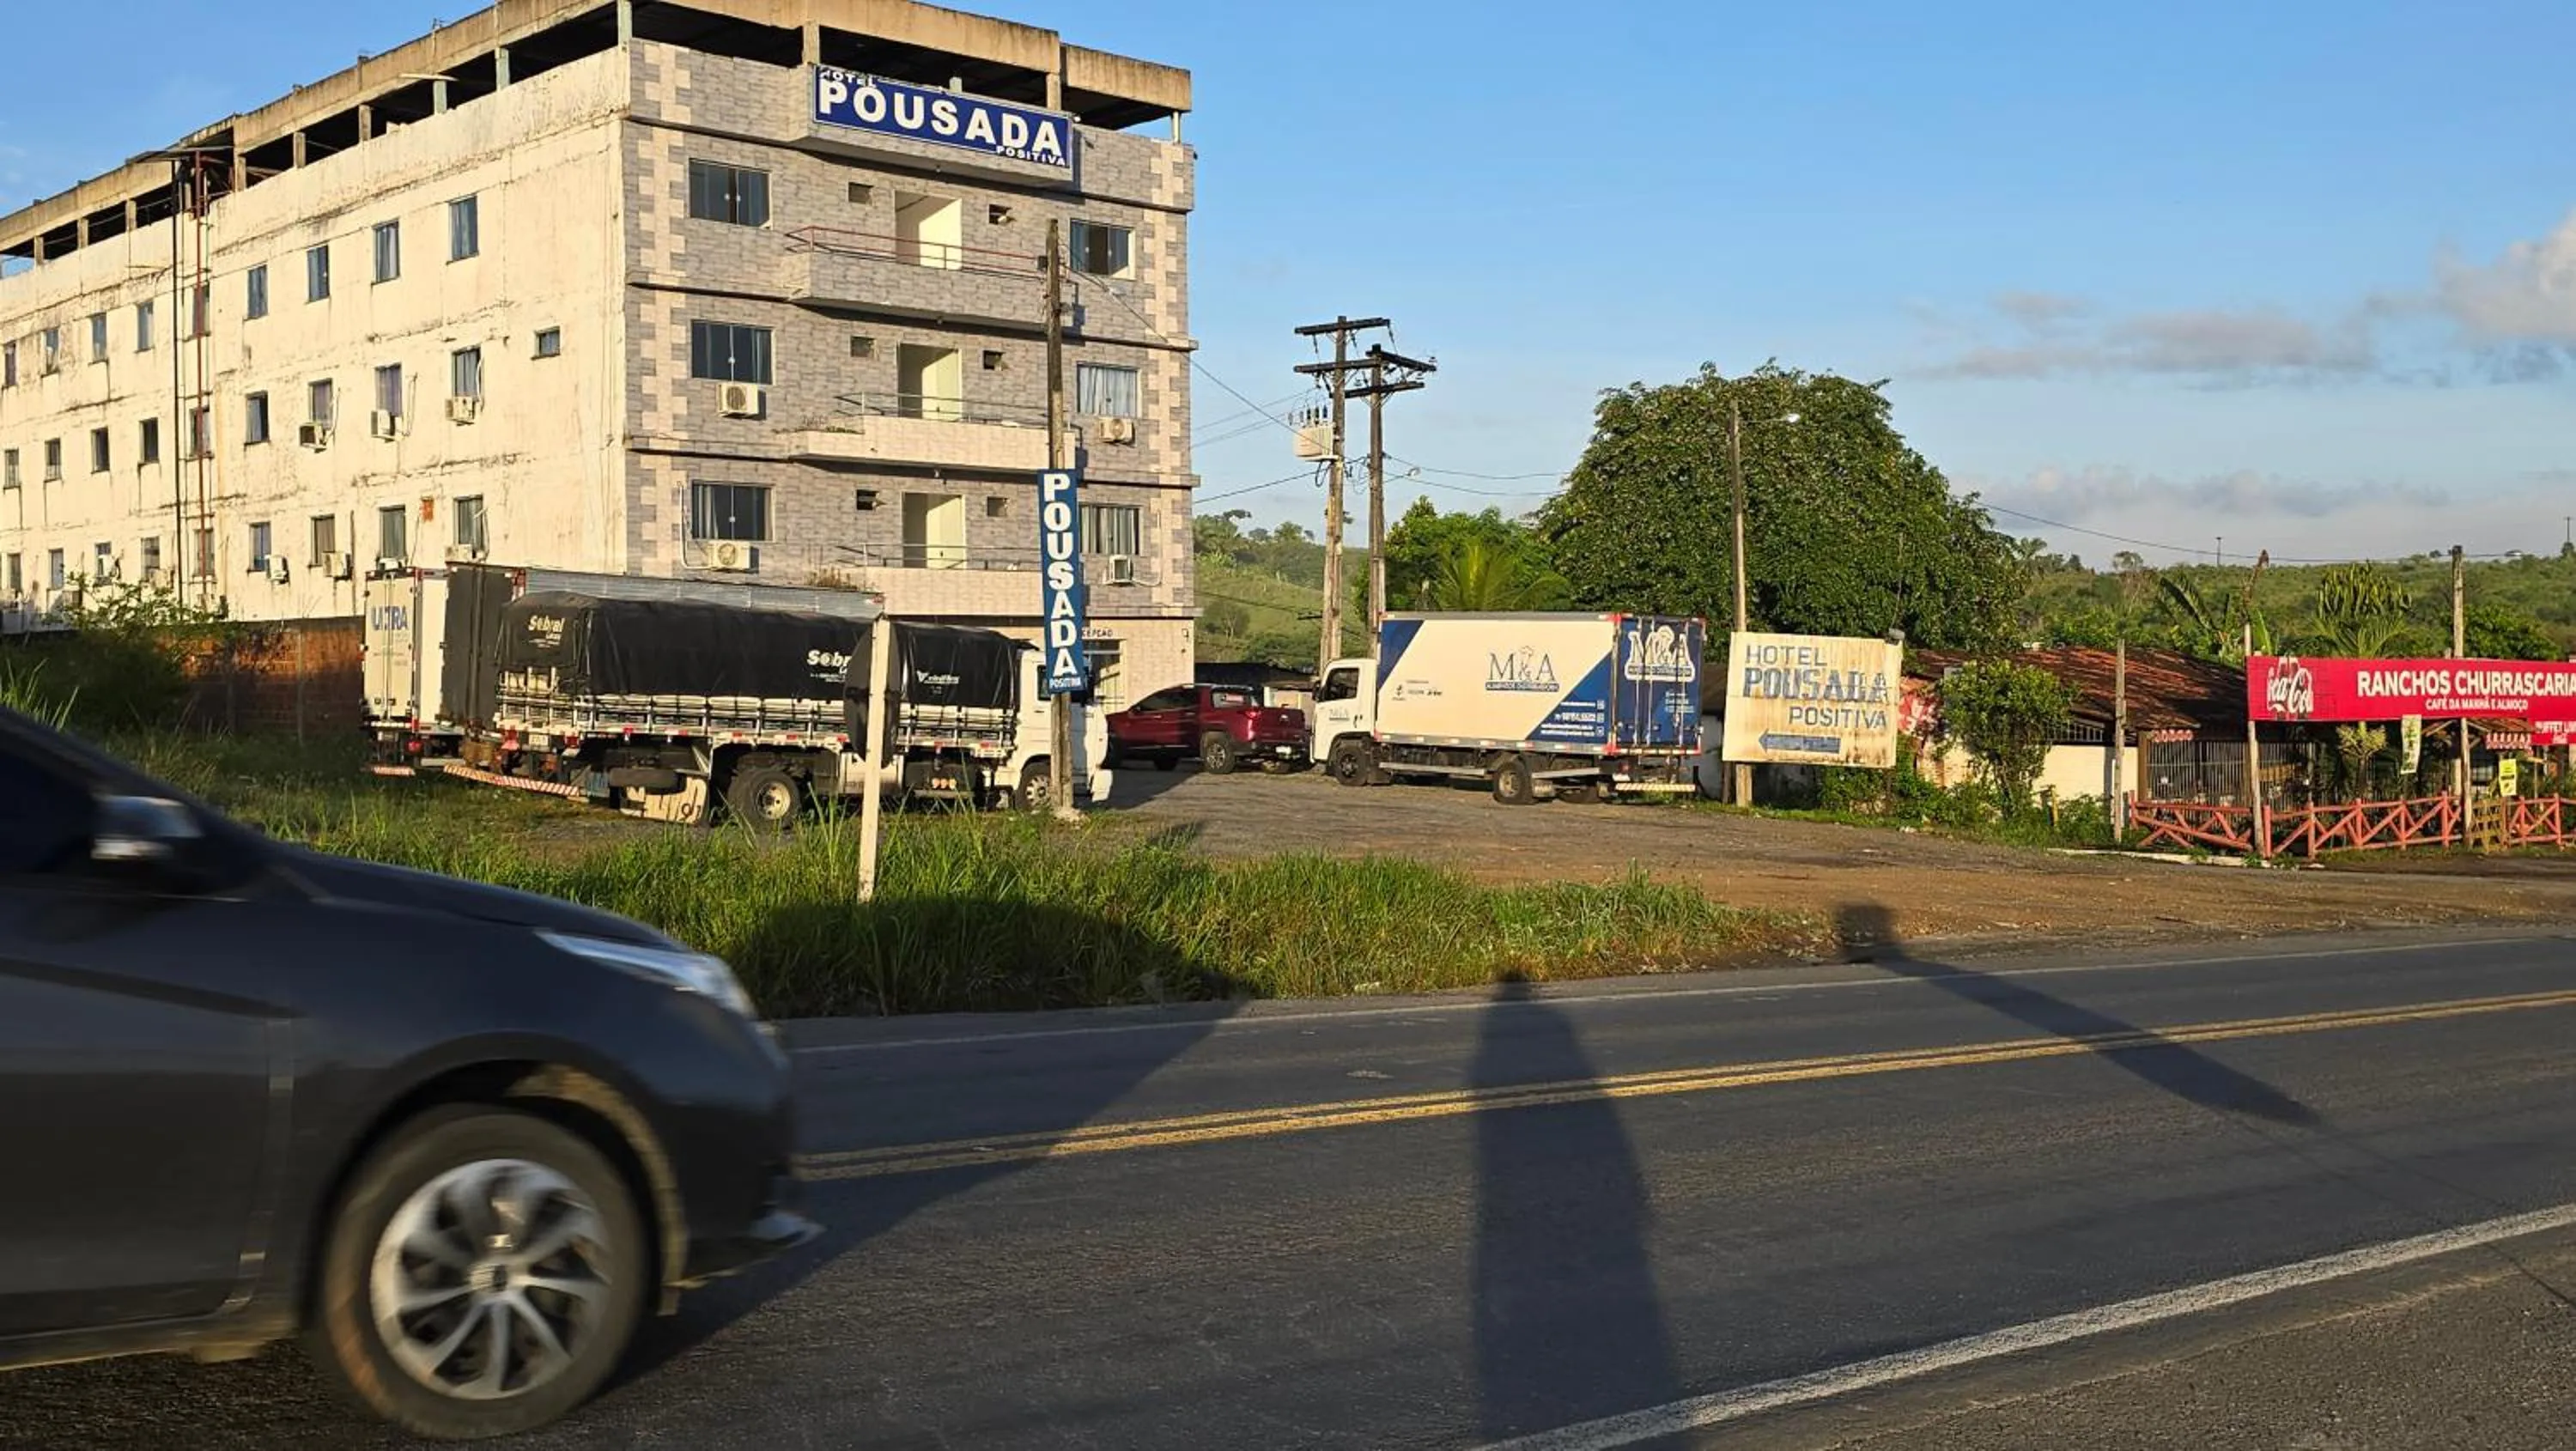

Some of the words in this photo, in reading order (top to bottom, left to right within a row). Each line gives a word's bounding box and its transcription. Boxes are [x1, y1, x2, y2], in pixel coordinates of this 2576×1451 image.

[820, 70, 878, 88] HOTEL
[819, 79, 1061, 157] POUSADA
[996, 145, 1066, 167] POSITIVA
[1043, 473, 1078, 677] POUSADA
[807, 649, 852, 667] Sobr
[1489, 648, 1555, 681] M&A
[1746, 645, 1827, 667] HOTEL
[1742, 666, 1888, 704] POUSADA
[2357, 670, 2451, 696] RANCHOS
[2455, 670, 2576, 696] CHURRASCARIA
[2426, 696, 2447, 710] CAFÉ
[2449, 698, 2460, 710] DA
[2462, 696, 2489, 710] MANHÃ
[2497, 698, 2529, 712] ALMOÇO
[1789, 707, 1887, 729] POSITIVA
